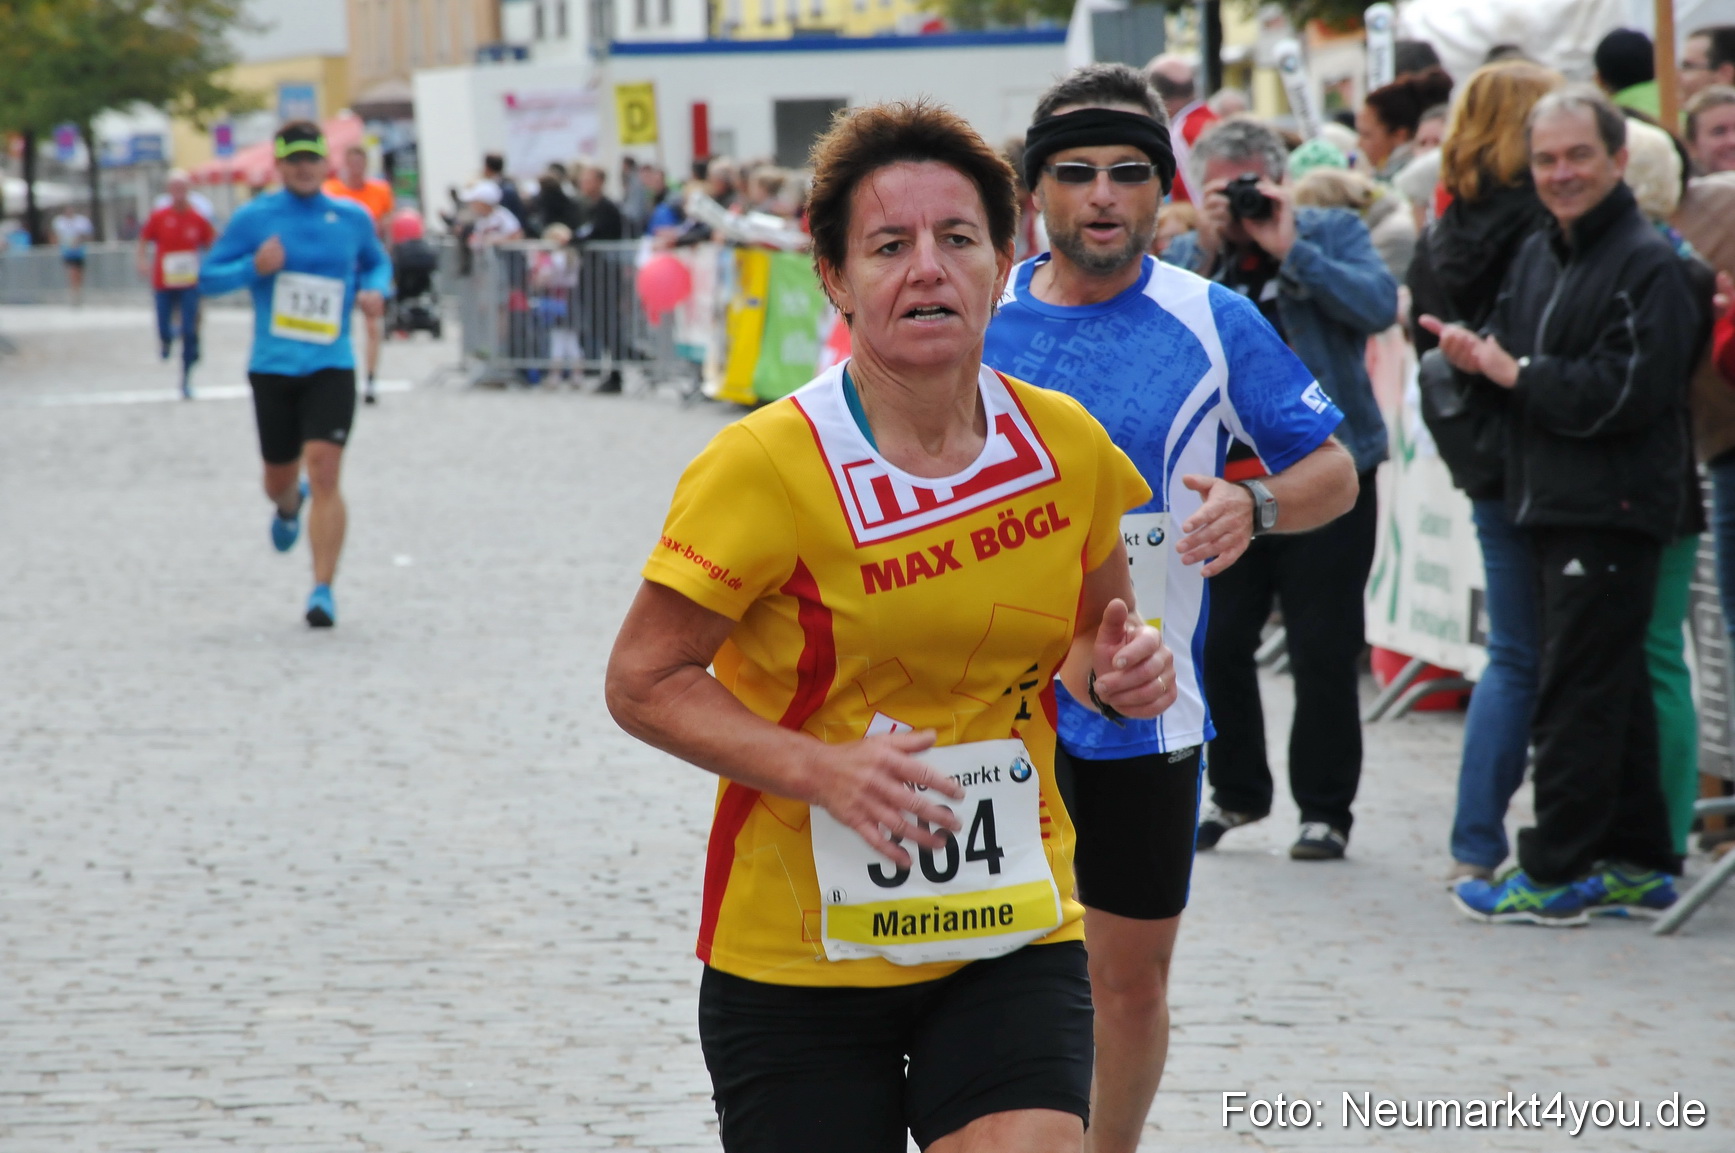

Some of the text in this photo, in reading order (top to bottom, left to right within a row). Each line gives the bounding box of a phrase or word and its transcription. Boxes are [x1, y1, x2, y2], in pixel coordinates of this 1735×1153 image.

[626, 101, 650, 132] D
[859, 501, 1071, 596] MAX BÖGL
[872, 902, 1014, 937] Marianne
